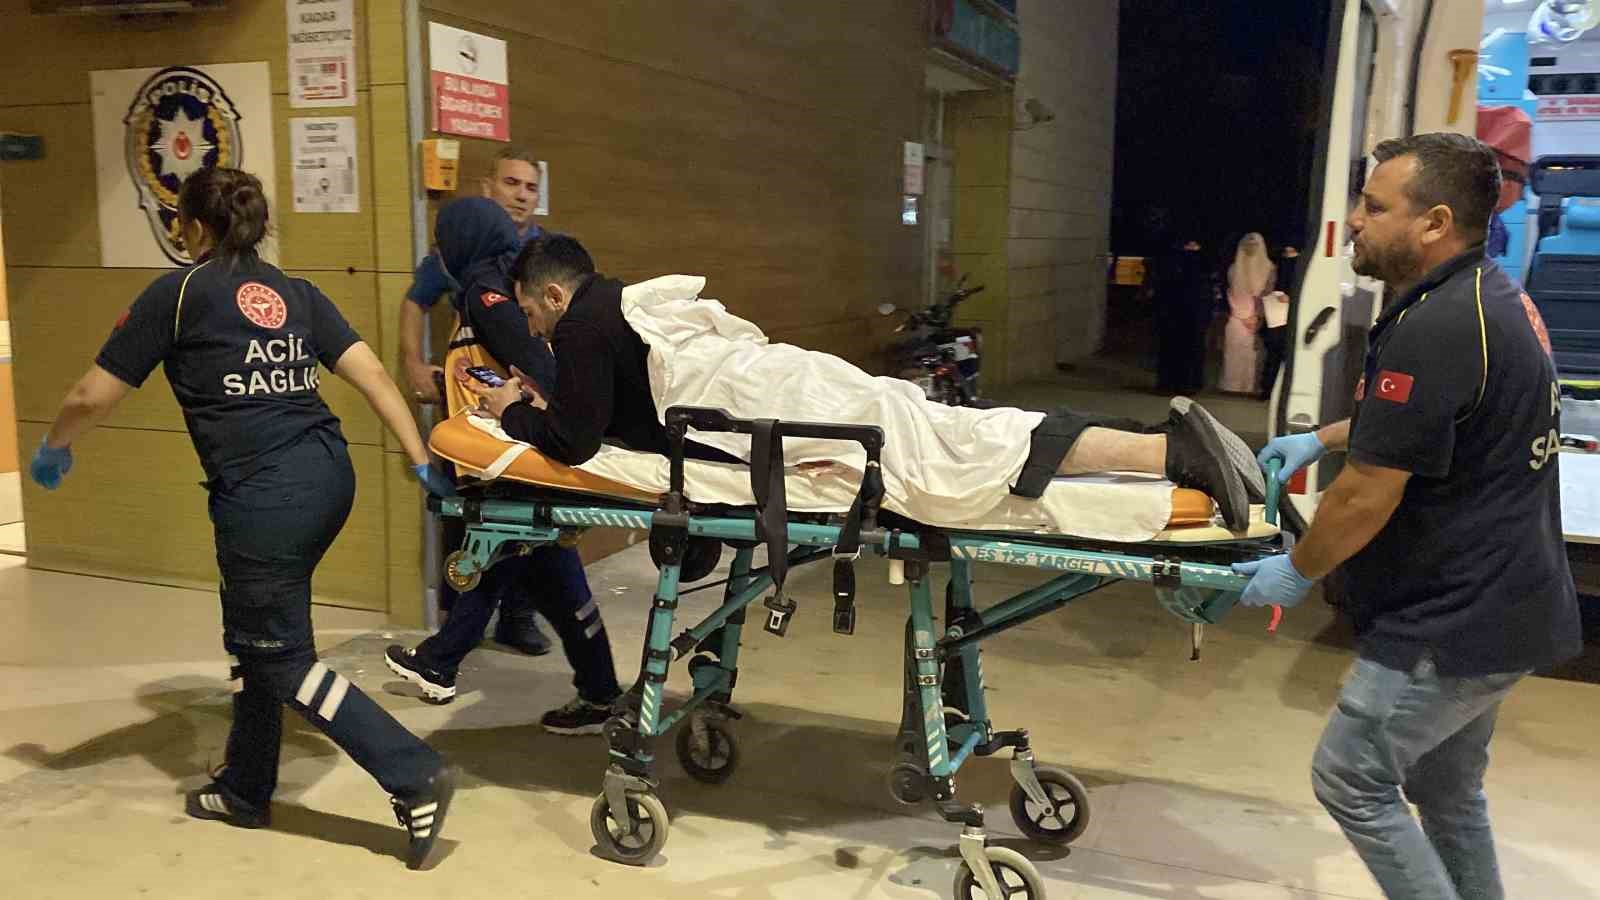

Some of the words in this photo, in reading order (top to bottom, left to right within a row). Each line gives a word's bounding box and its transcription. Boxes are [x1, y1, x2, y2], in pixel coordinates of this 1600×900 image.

[244, 333, 309, 363] ACİL
[976, 548, 997, 561] ES
[1037, 553, 1103, 573] TARGET
